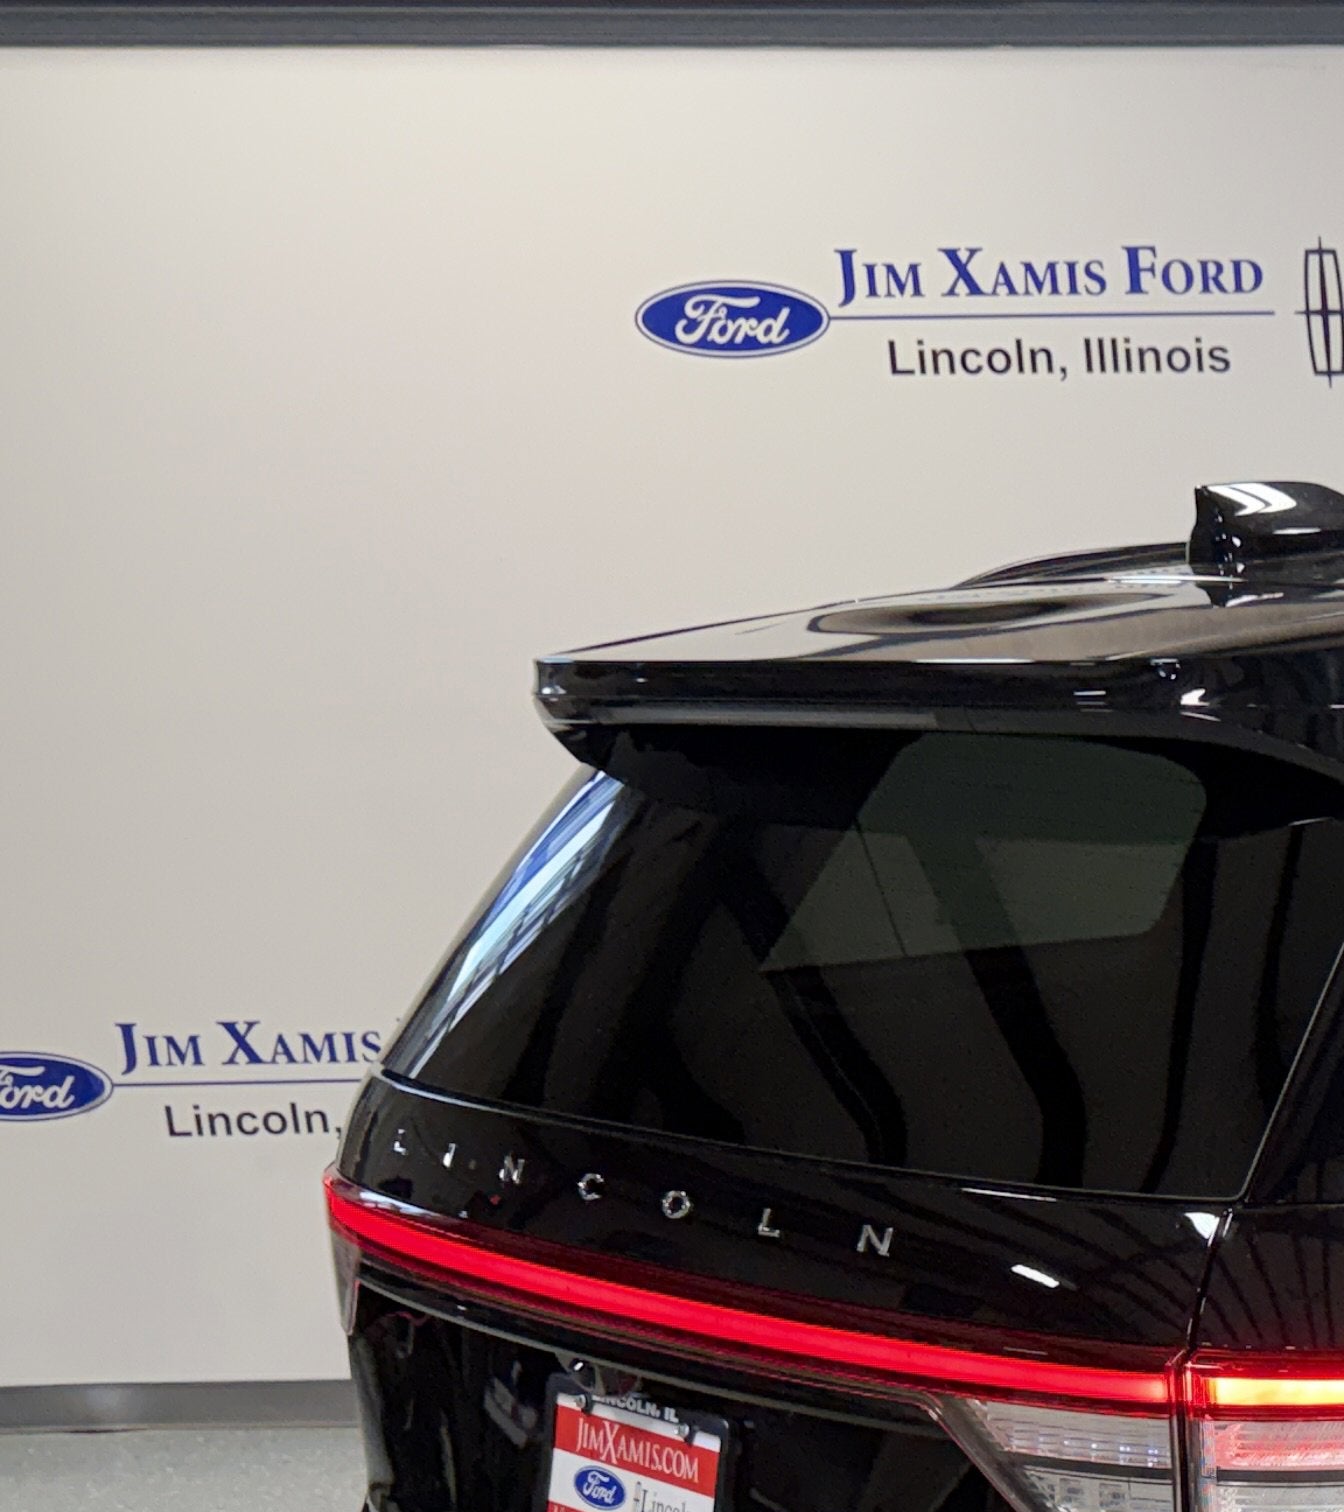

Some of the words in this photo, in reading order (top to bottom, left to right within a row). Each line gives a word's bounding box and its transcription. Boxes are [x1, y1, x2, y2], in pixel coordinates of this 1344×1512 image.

[674, 294, 791, 346] Ford
[887, 338, 1068, 382] Lincoln,
[1085, 337, 1231, 374] Illinois
[164, 1101, 342, 1139] Lincoln,
[393, 1128, 894, 1257] LINCOLN
[663, 1406, 679, 1424] IL
[582, 1470, 617, 1505] Ford
